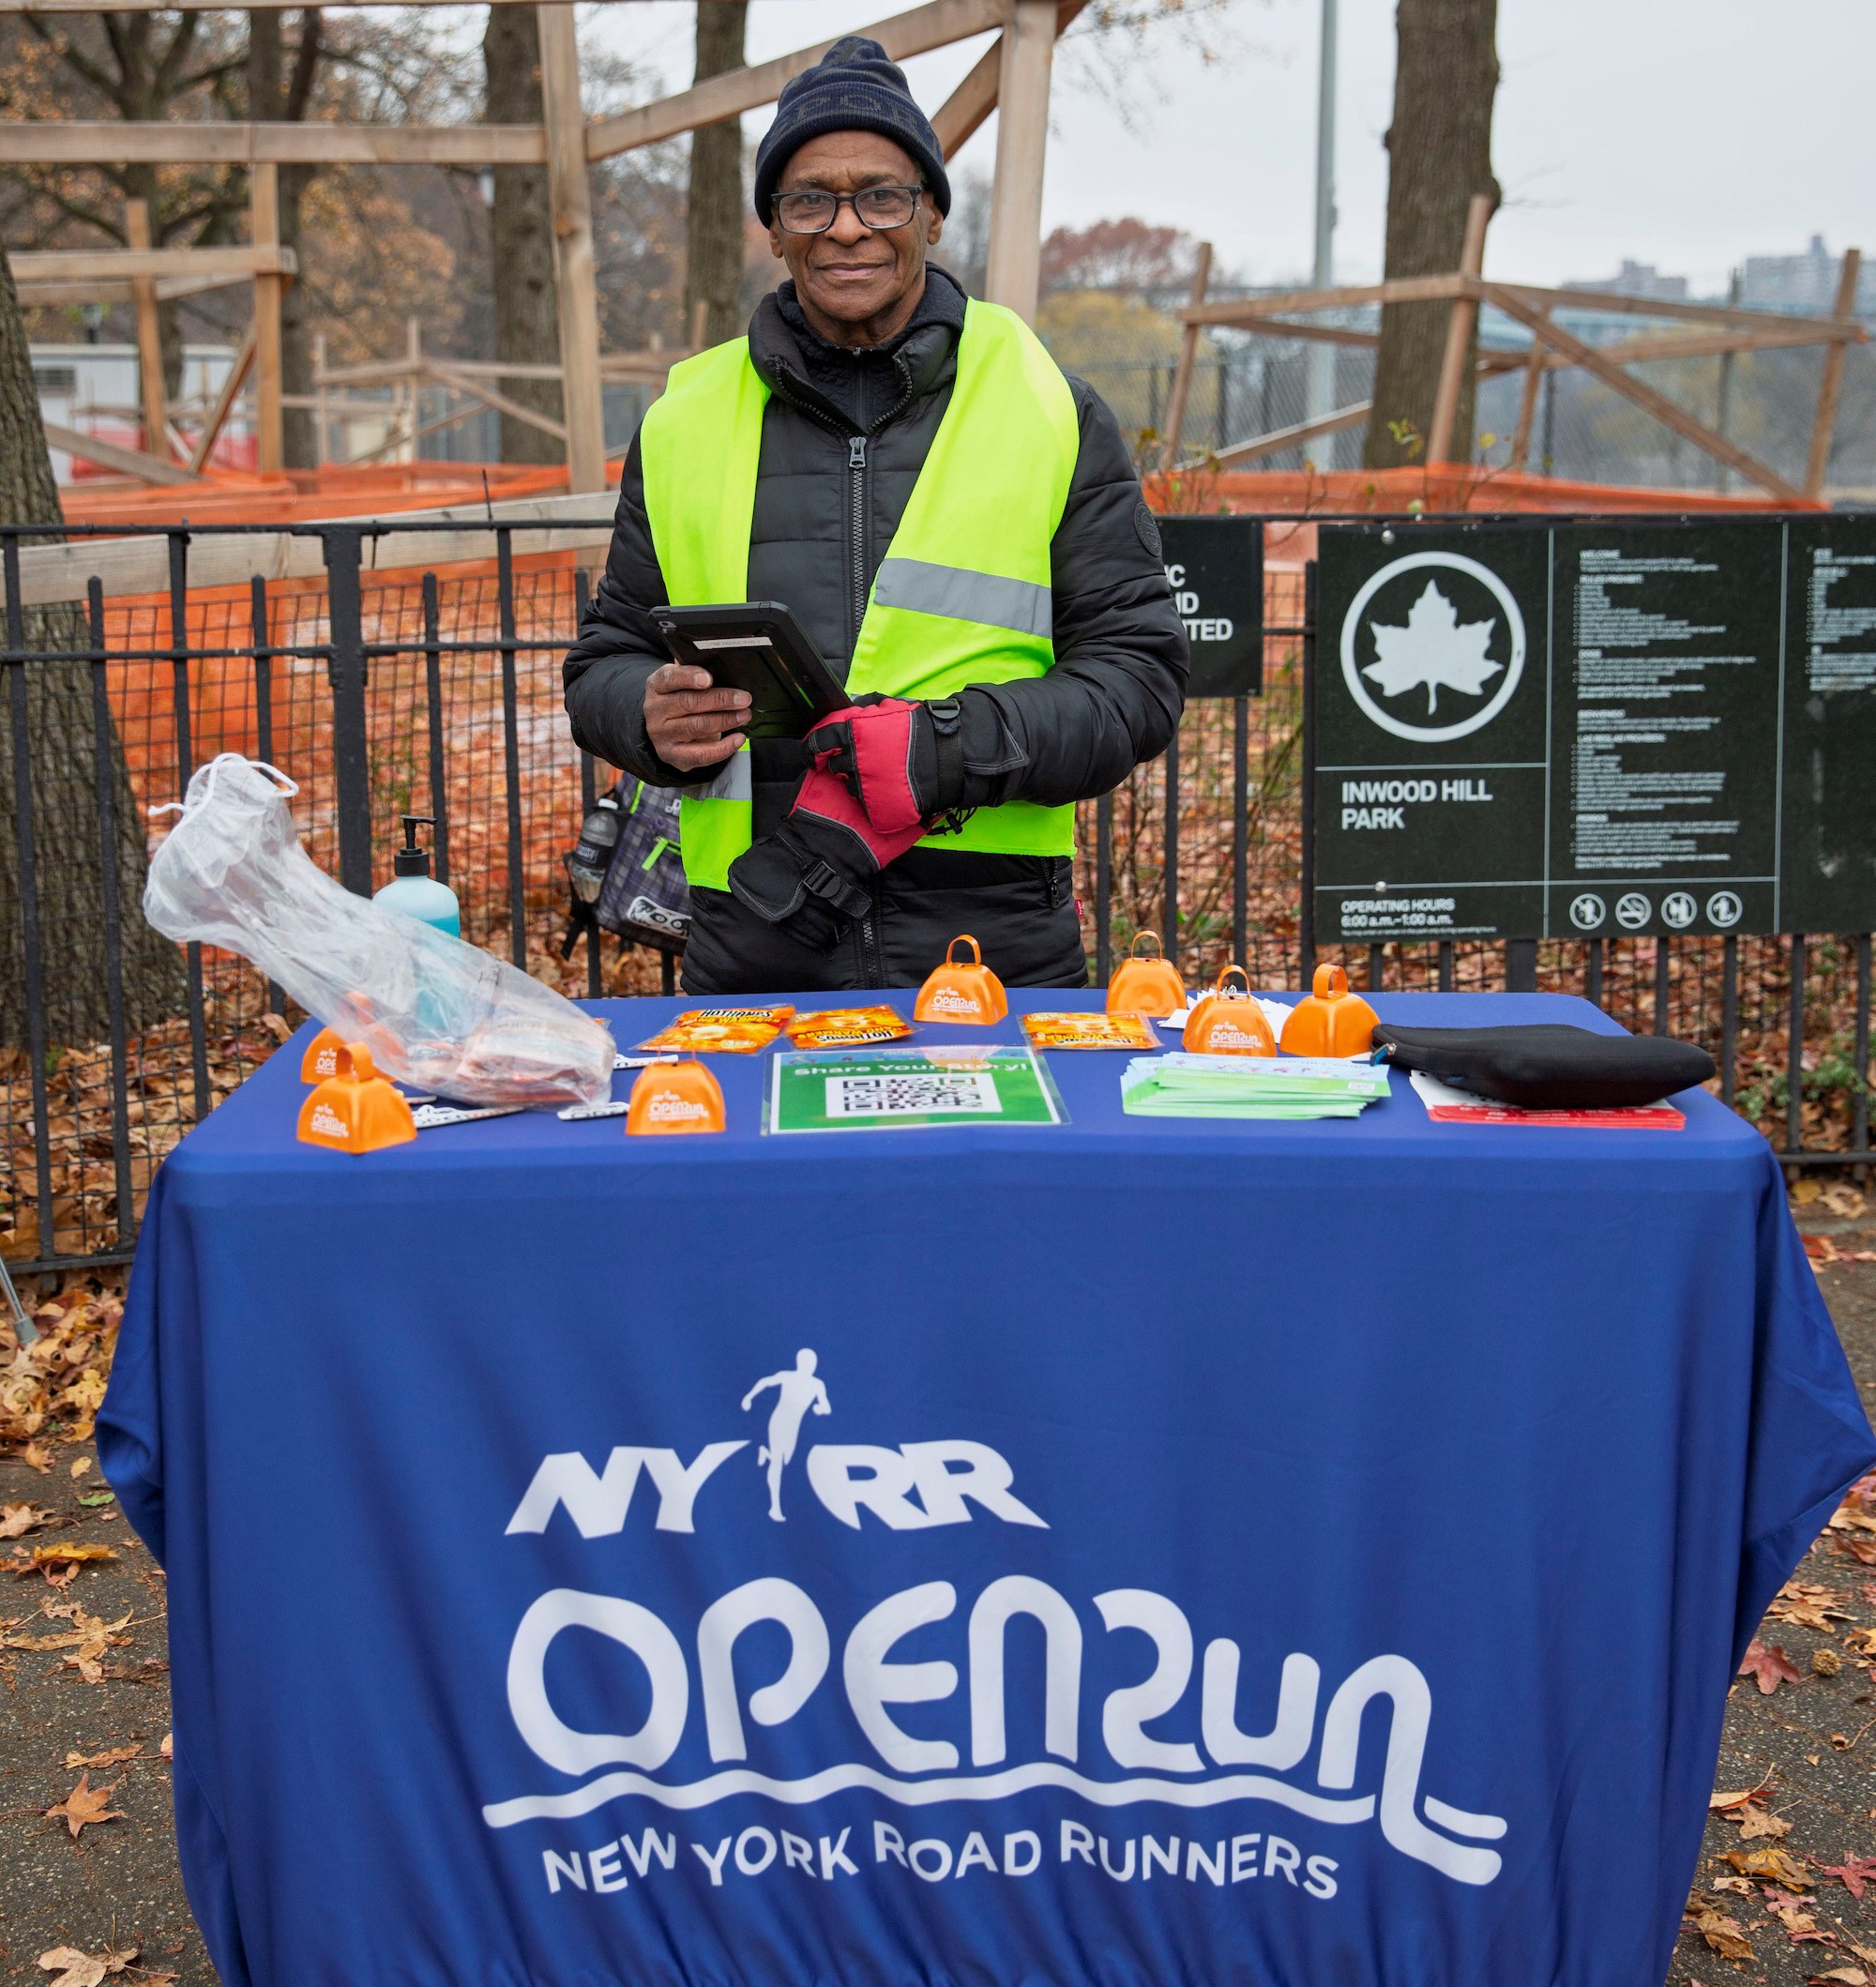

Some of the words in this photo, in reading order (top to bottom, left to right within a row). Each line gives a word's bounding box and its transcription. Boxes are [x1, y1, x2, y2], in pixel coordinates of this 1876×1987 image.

[1341, 780, 1438, 804] INWOOD
[1441, 779, 1493, 801] HILL
[1341, 807, 1405, 830] PARK
[1340, 899, 1411, 914] OPERATING
[1412, 898, 1456, 912] HOURS
[1340, 914, 1369, 928] 6:00
[1427, 913, 1454, 925] a.m.
[794, 1066, 871, 1076] Share
[877, 1063, 940, 1072] Your
[947, 1062, 1027, 1072] Story!
[543, 1828, 676, 1893] NEW
[692, 1827, 859, 1886] YORK
[874, 1821, 1041, 1882] ROAD
[1061, 1820, 1339, 1900] RUNNERS
